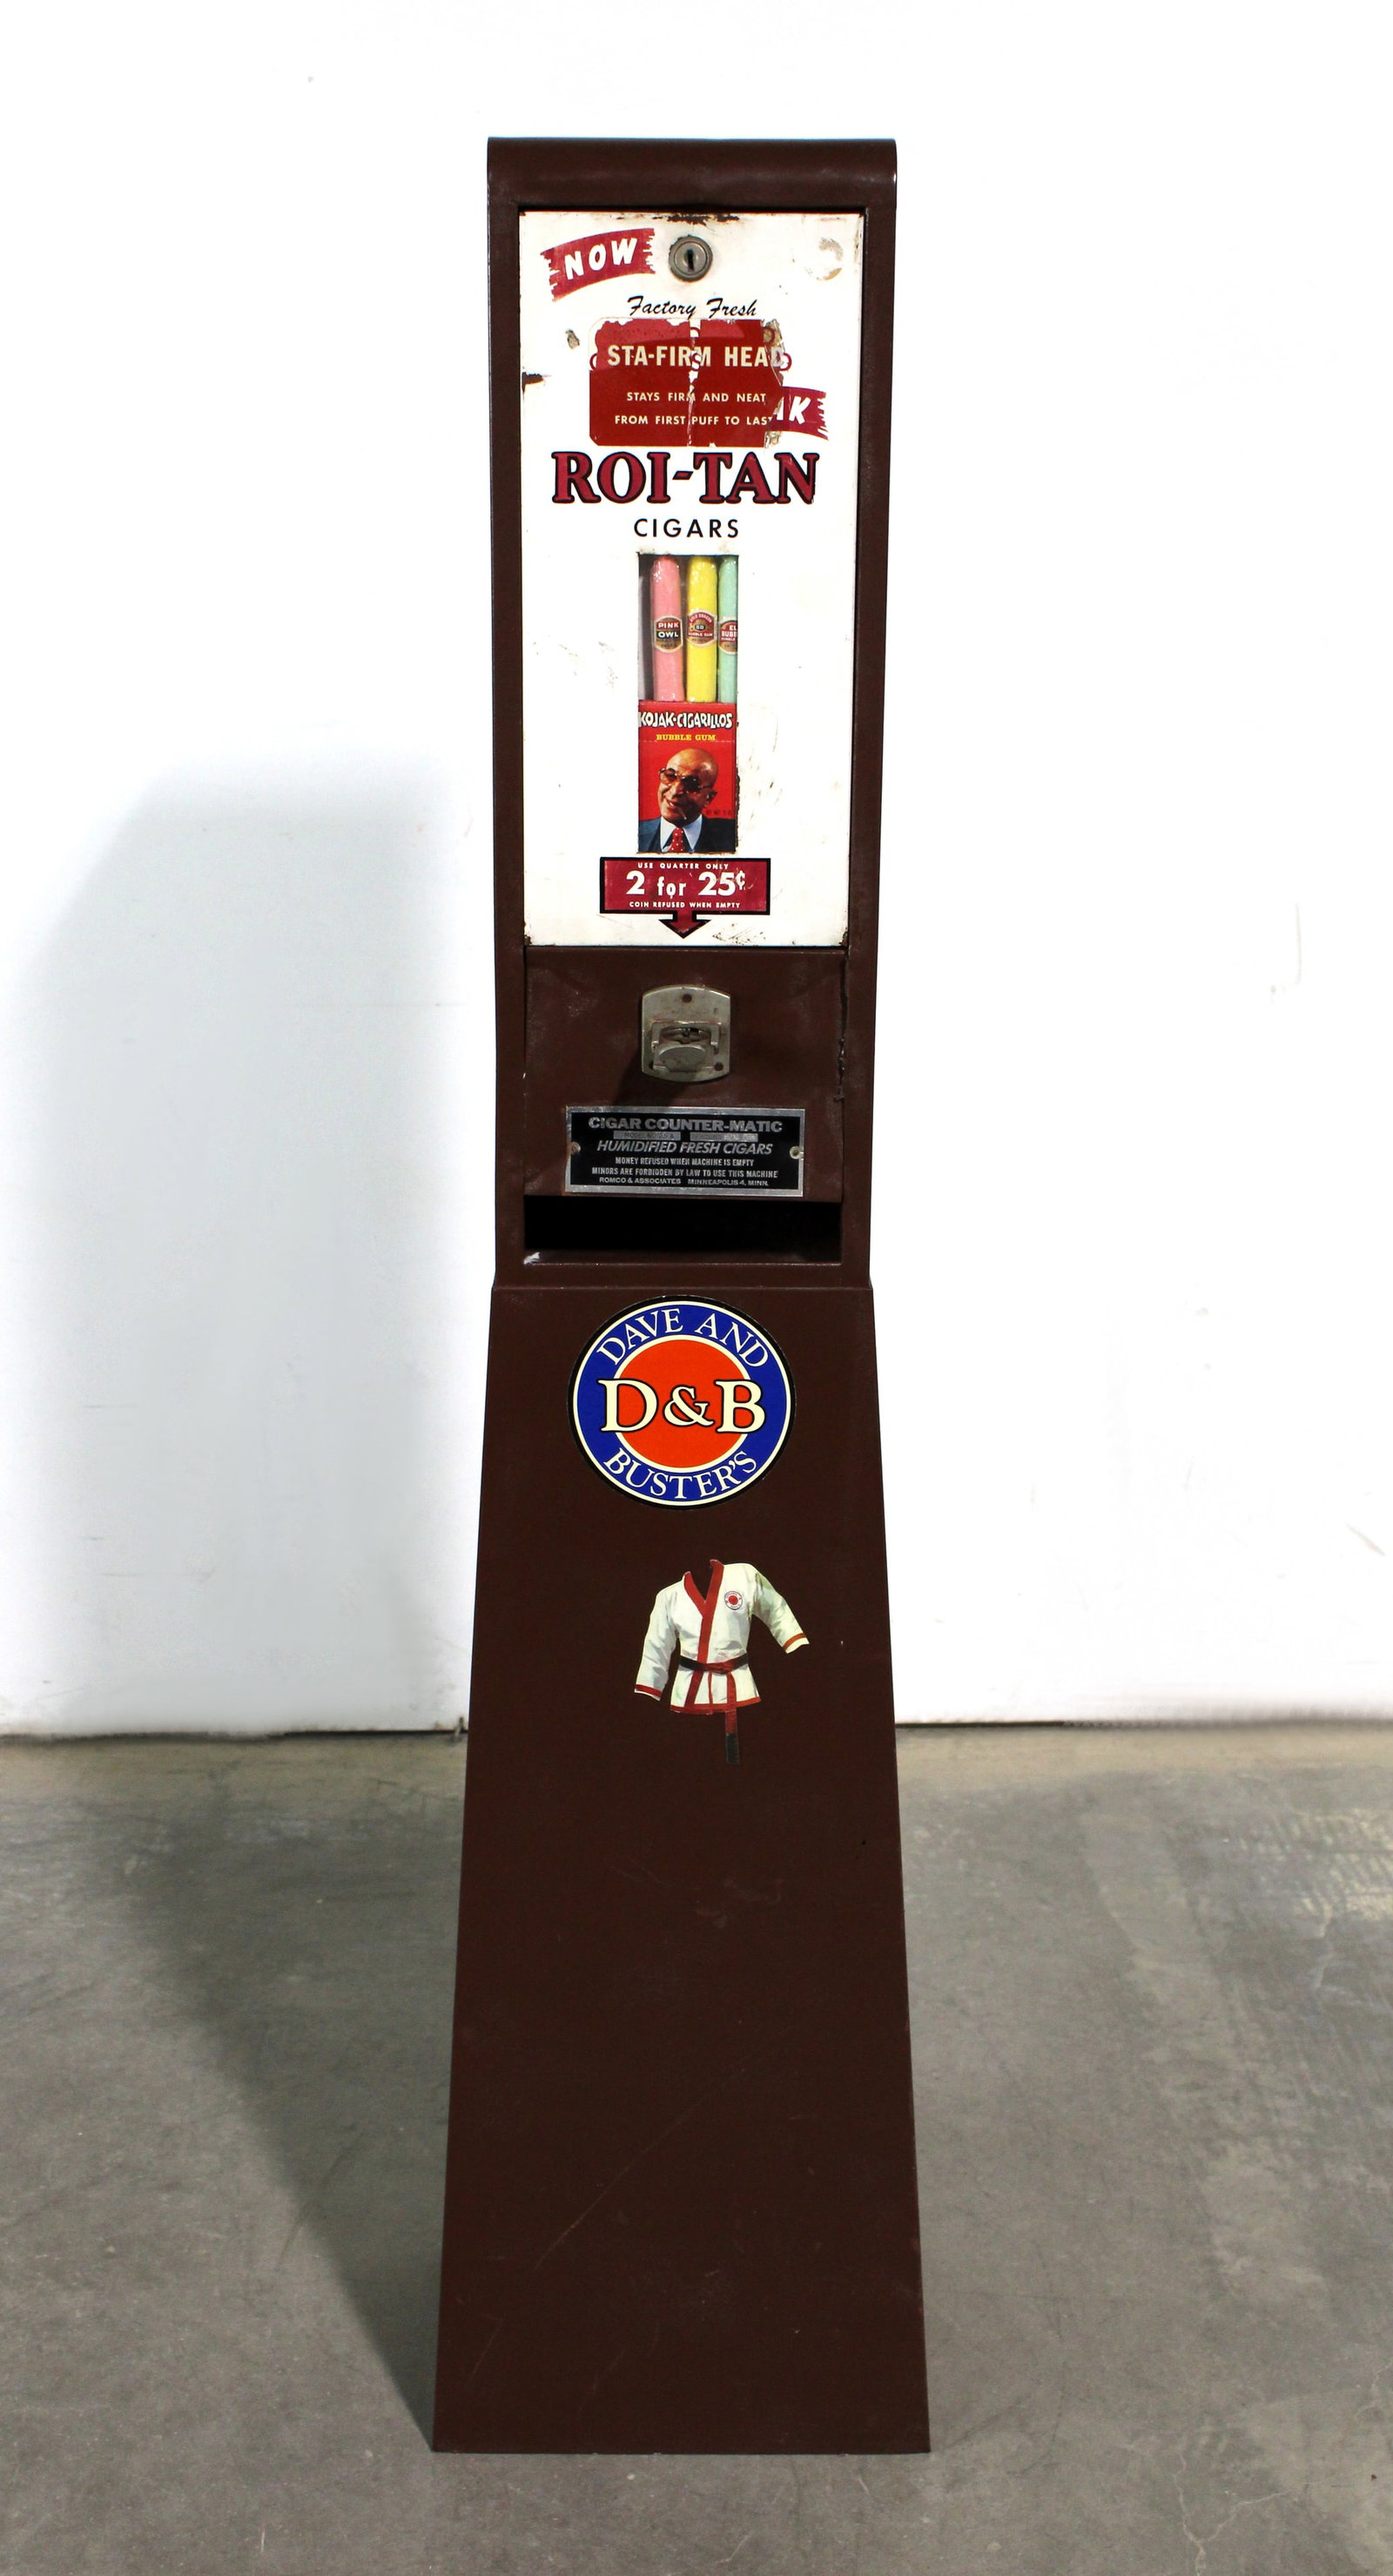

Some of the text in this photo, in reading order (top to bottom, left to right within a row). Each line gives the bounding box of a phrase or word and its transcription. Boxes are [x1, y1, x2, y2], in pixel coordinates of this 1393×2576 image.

[564, 238, 637, 280] NOW
[627, 296, 757, 319] Factory Fresh
[724, 346, 784, 368] HEAD
[627, 392, 766, 402] STAYS FIRM AND NEAT
[615, 415, 648, 425] FROM
[656, 415, 685, 425] FIRST
[691, 416, 719, 425] PUFF
[724, 416, 740, 425] TO
[551, 451, 820, 504] ROI-TAN
[634, 518, 739, 538] CIGARS
[626, 870, 745, 898] 2 for 25¢
[589, 1116, 783, 1132] CIGAR COUNTER-MATIC
[597, 1140, 773, 1155] HUMIDIFIED FRESH CIGARS
[635, 1168, 673, 1177] FORBIDDEN
[596, 1308, 769, 1367] DAVE AND
[597, 1379, 767, 1433] D&B
[603, 1447, 757, 1500] BUSTER'S
